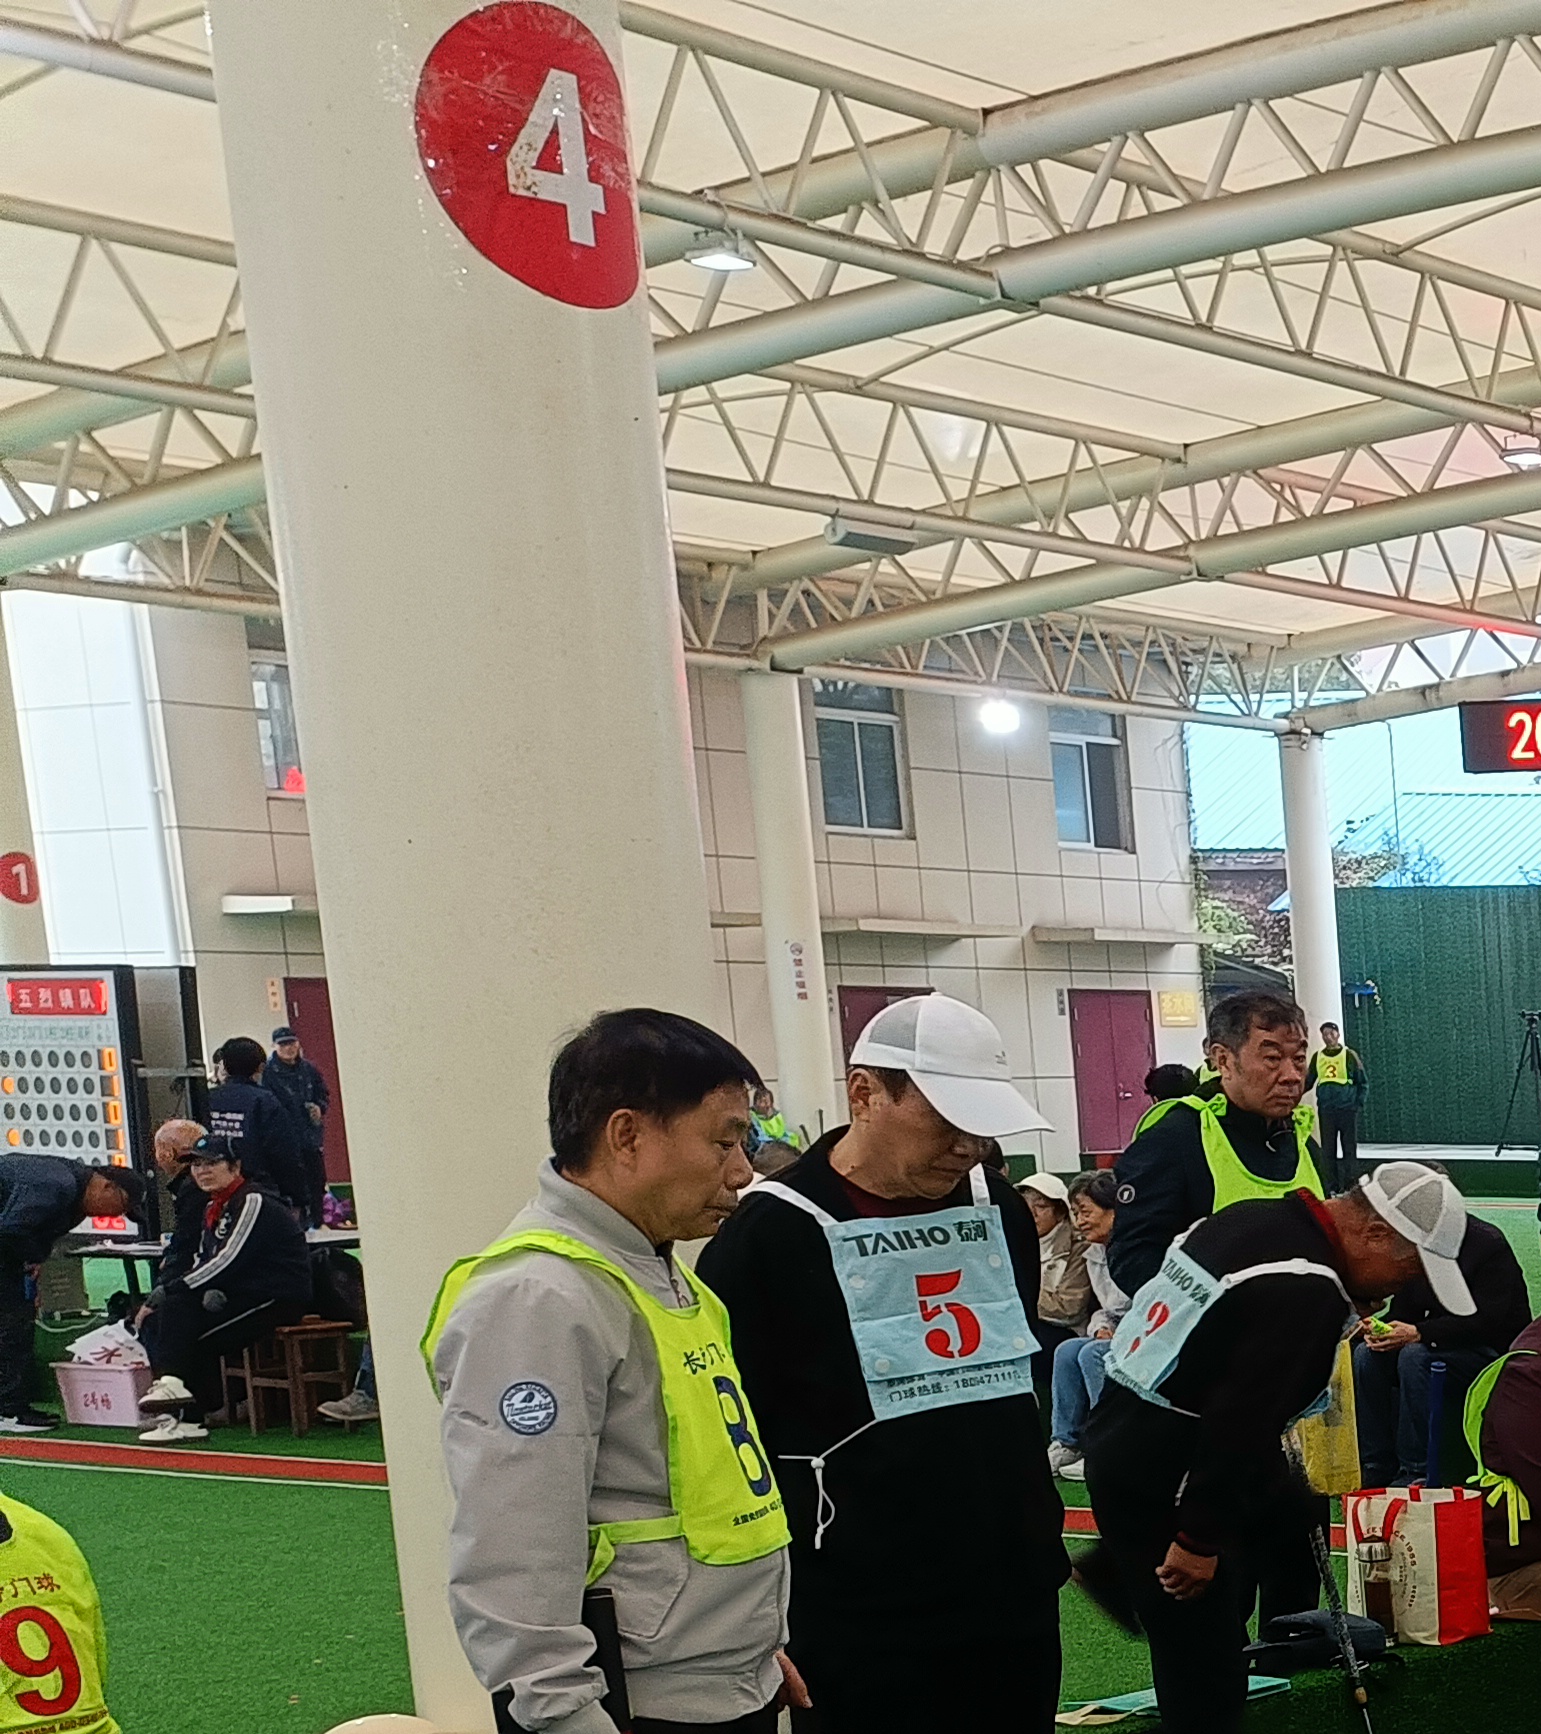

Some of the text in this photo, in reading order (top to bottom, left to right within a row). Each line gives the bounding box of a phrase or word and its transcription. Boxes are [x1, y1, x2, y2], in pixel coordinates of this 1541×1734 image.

[506, 67, 607, 248] 4
[11, 862, 29, 896] 1
[1325, 1064, 1337, 1078] 3
[842, 1226, 950, 1257] TAIHO
[1161, 1258, 1194, 1292] TAIHO
[915, 1268, 981, 1359] 5
[712, 1375, 772, 1497] 8
[0, 1606, 82, 1717] 9
